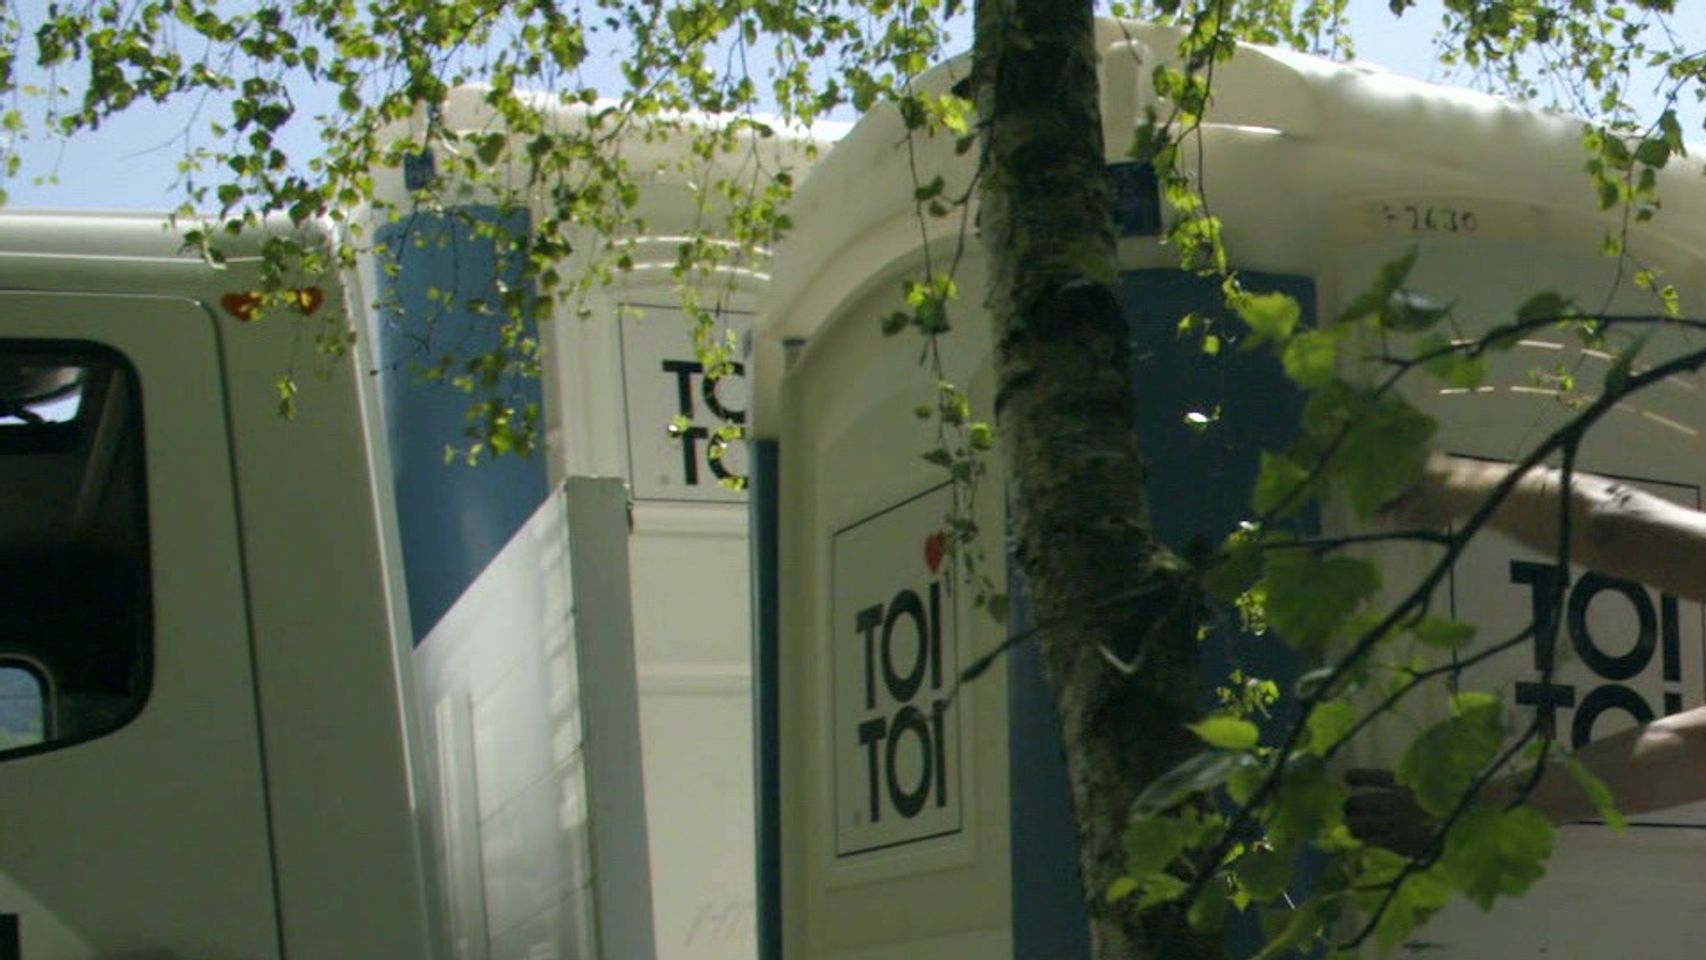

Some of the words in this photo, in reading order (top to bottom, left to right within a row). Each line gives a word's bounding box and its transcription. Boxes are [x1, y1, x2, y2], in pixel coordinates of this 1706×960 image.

[662, 359, 747, 424] TO
[669, 427, 748, 487] TO
[856, 580, 941, 710] TOI
[1510, 560, 1682, 682] TOI
[858, 700, 947, 824] TOI
